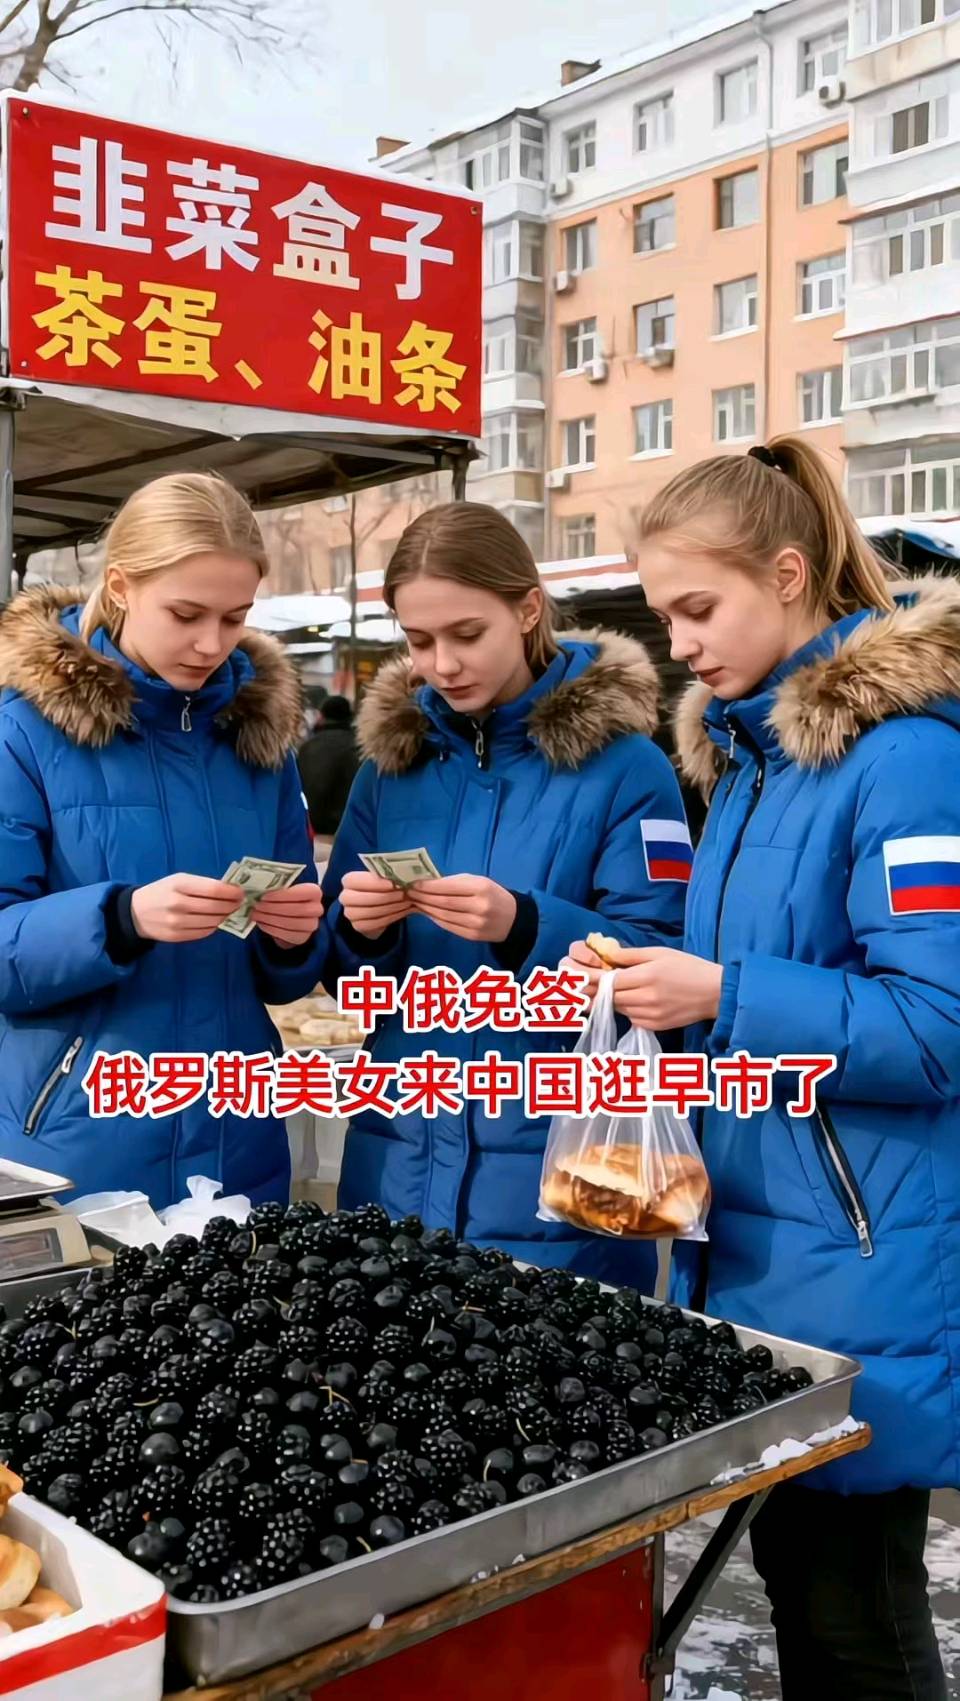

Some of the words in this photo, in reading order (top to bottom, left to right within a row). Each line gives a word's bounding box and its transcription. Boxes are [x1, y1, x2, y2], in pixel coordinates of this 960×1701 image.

[45, 136, 454, 300] 韭菜盒子
[32, 265, 467, 413] 茶蛋、油条
